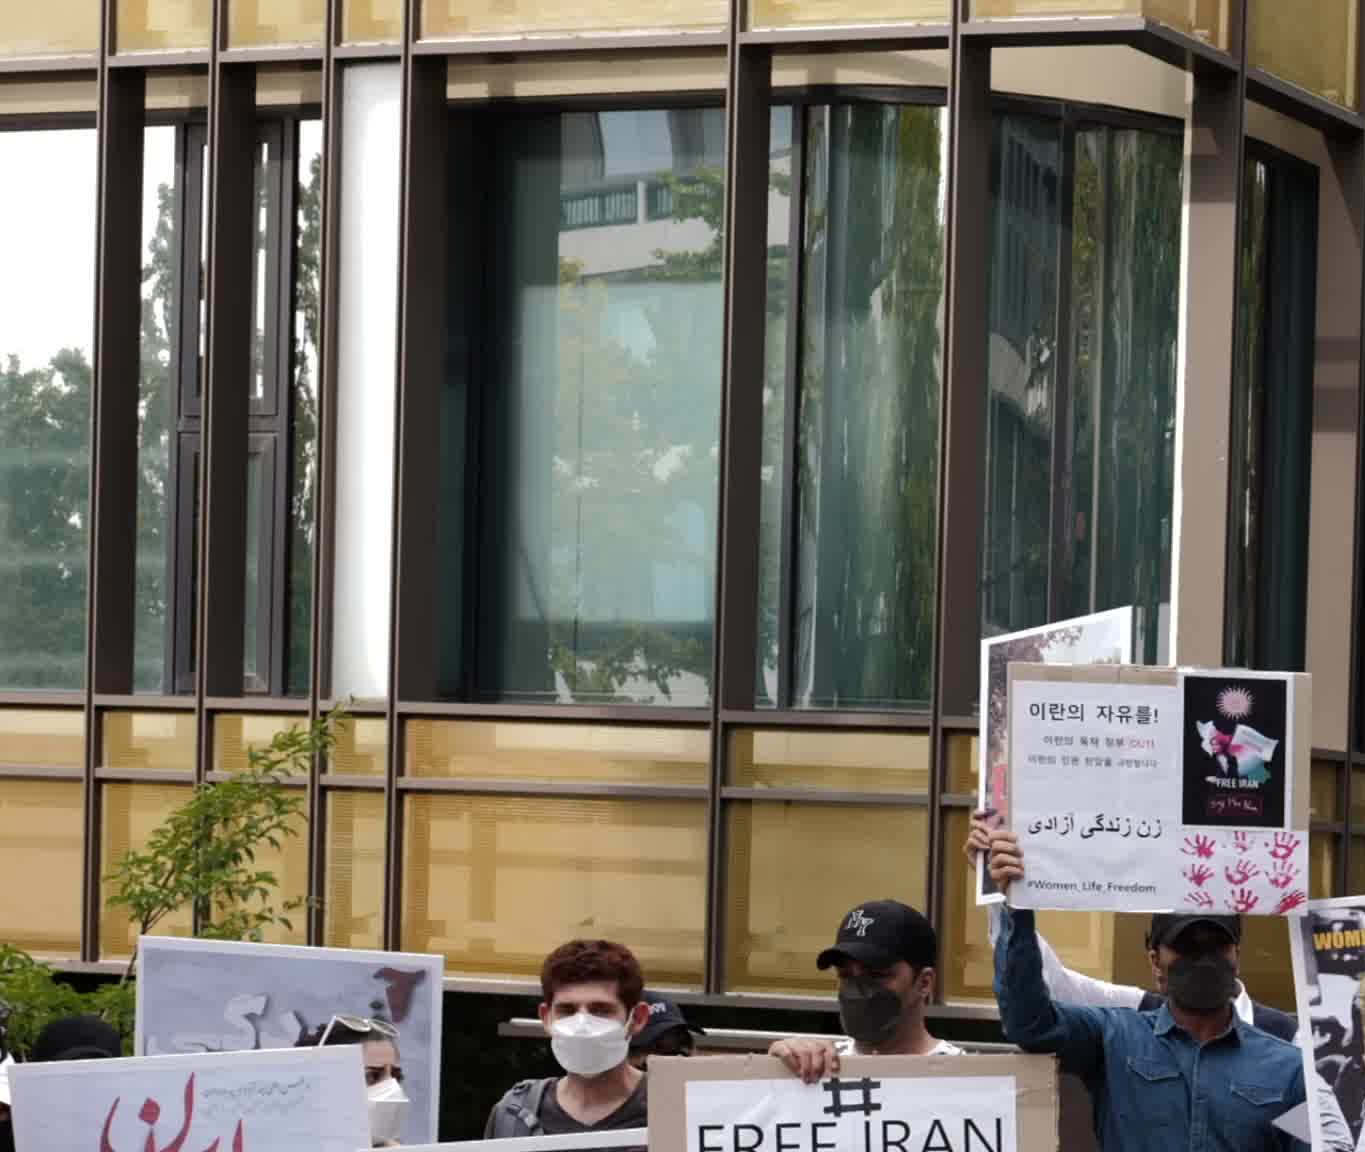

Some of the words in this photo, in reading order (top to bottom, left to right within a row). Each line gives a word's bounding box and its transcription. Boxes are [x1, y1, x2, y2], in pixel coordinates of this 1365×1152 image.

[1029, 702, 1084, 722] 이란의
[1096, 704, 1158, 725] 자유를!
[1028, 811, 1074, 836] آزادی
[1080, 813, 1131, 839] زندگی
[1136, 818, 1162, 839] زن
